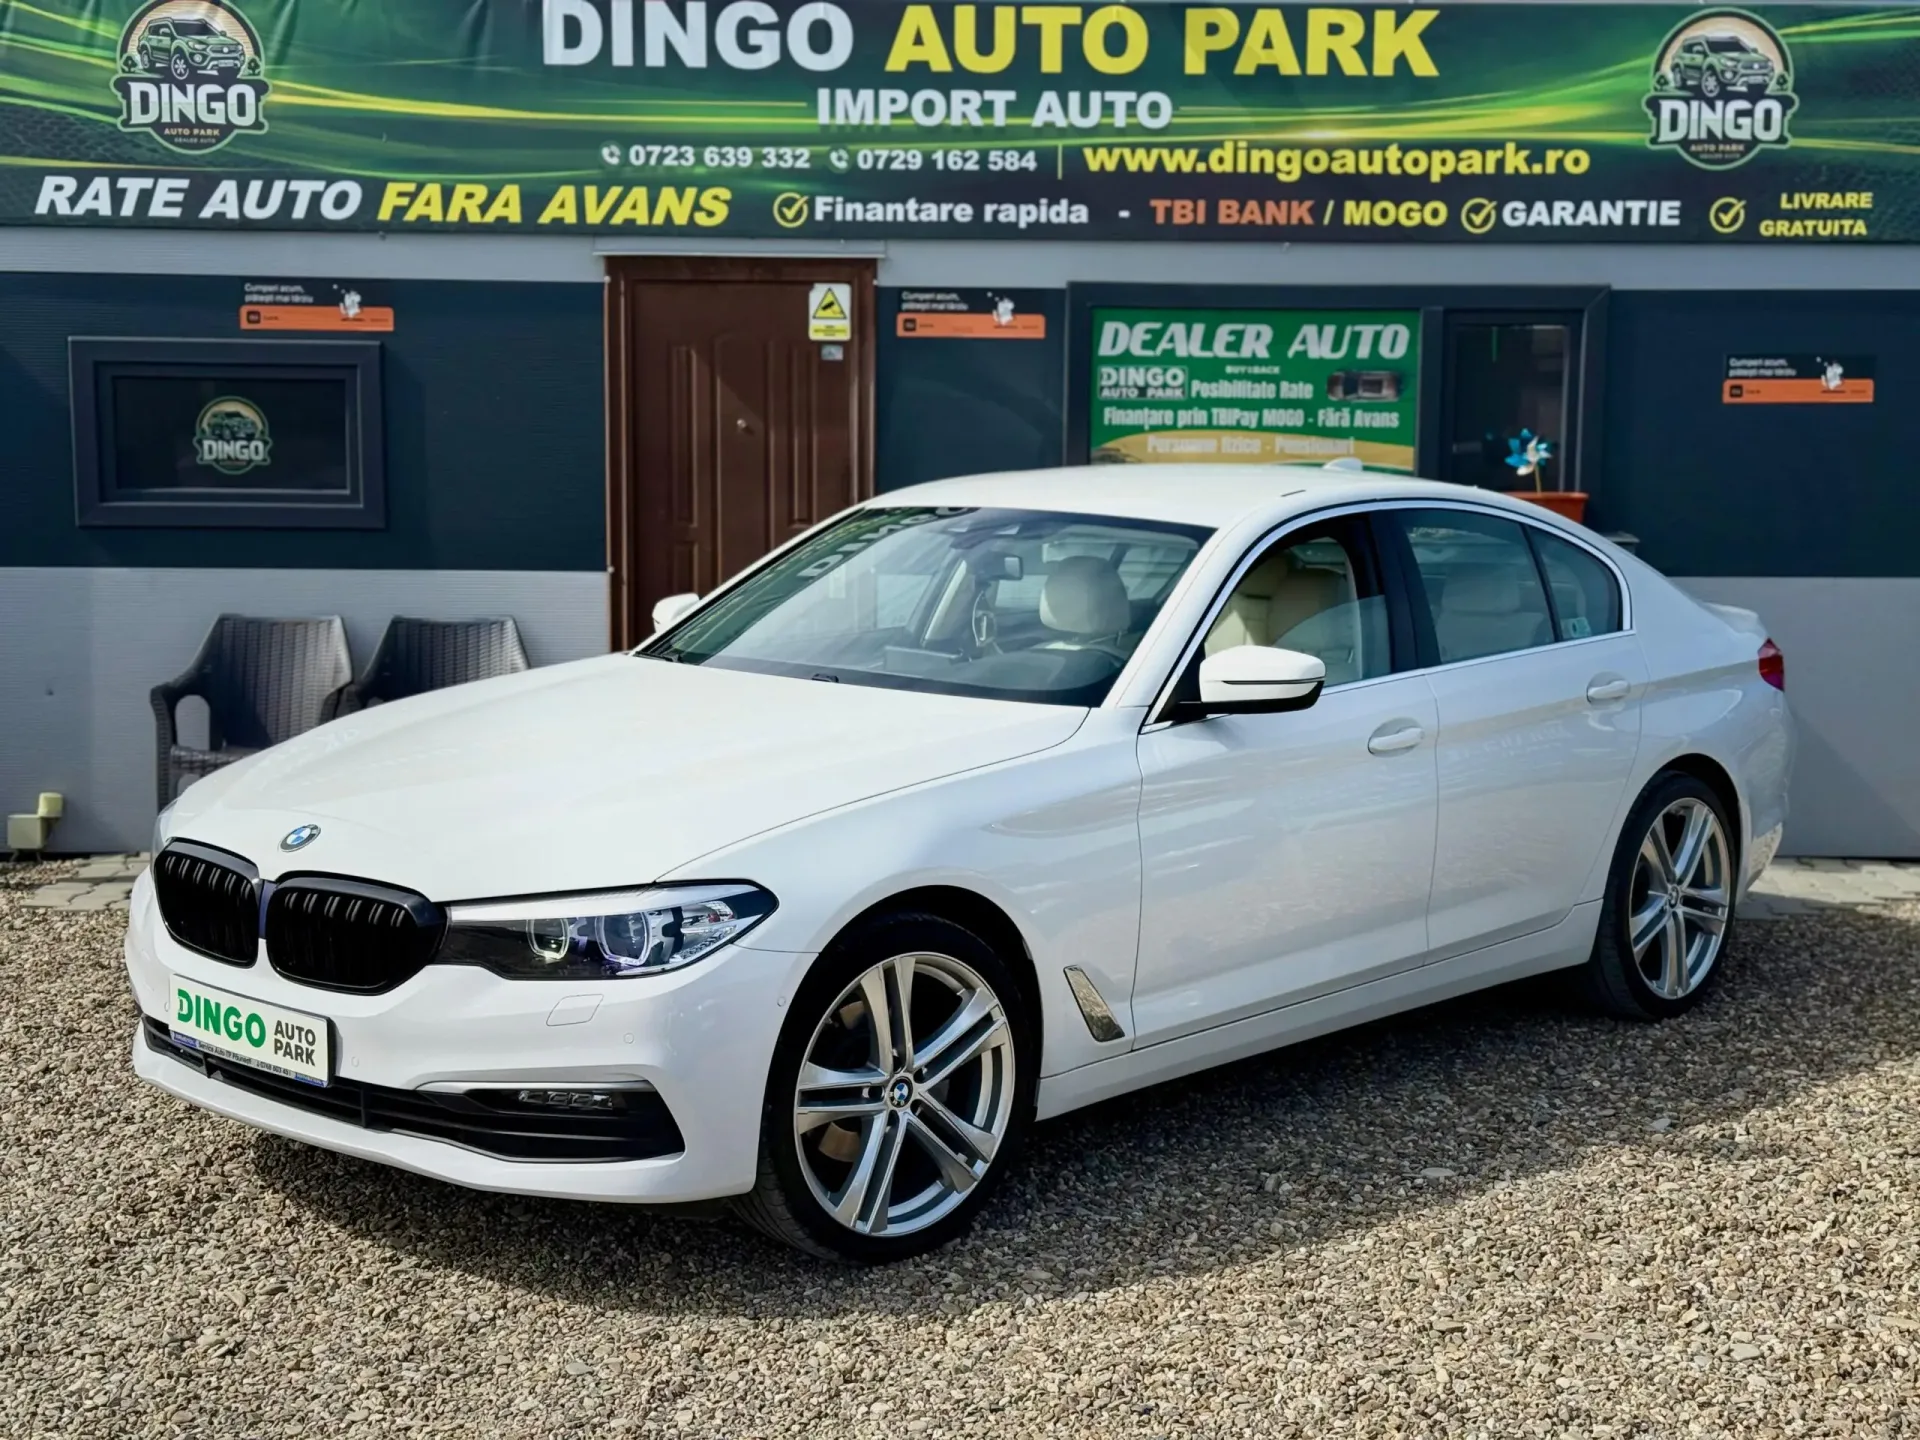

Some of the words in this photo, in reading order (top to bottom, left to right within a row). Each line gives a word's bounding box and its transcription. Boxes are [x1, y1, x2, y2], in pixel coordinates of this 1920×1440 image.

[542, 0, 854, 71] DINGO
[884, 4, 1149, 75] AUTO
[1184, 7, 1439, 77] PARK
[128, 81, 257, 127] DINGO
[817, 88, 1016, 126] IMPORT
[1031, 90, 1173, 129] AUTO
[164, 127, 190, 136] AUTO
[193, 127, 220, 136] PARK
[1658, 99, 1783, 143] DINGO
[629, 145, 696, 168] 0723
[703, 145, 753, 169] 639
[761, 147, 811, 170] 332
[1689, 143, 1717, 152] AUTO
[1719, 143, 1745, 152] PARK
[857, 149, 923, 171] 0729
[931, 150, 979, 172] 162
[988, 150, 1037, 173] 584
[1083, 141, 1590, 183] www.dingoautopark.ro
[34, 175, 190, 218] RATE
[199, 179, 364, 221] AUTO
[376, 182, 522, 224] FARA
[537, 185, 732, 228] AVANS
[814, 196, 974, 223] Finantare
[983, 198, 1089, 229] rapida
[1150, 199, 1205, 225] TBI
[1217, 200, 1315, 226] BANK
[1343, 200, 1448, 227] MOGO
[1502, 200, 1681, 227] GARANTIE
[1779, 192, 1873, 210] LIVRARE
[1759, 219, 1867, 237] GRATUITA
[1098, 321, 1273, 358] DEALER
[1287, 323, 1410, 359] AUTO
[1100, 366, 1185, 387] DINGO
[1100, 387, 1139, 398] AUTO
[1147, 387, 1185, 399] PARK
[1279, 381, 1314, 400] Rate
[1177, 407, 1208, 429] prin
[1262, 409, 1304, 427] MOGO
[1353, 410, 1399, 429] Avans
[203, 439, 264, 461] DINGO
[177, 988, 266, 1048] DINGO
[274, 1020, 316, 1046] AUTO
[274, 1038, 315, 1066] PARK
